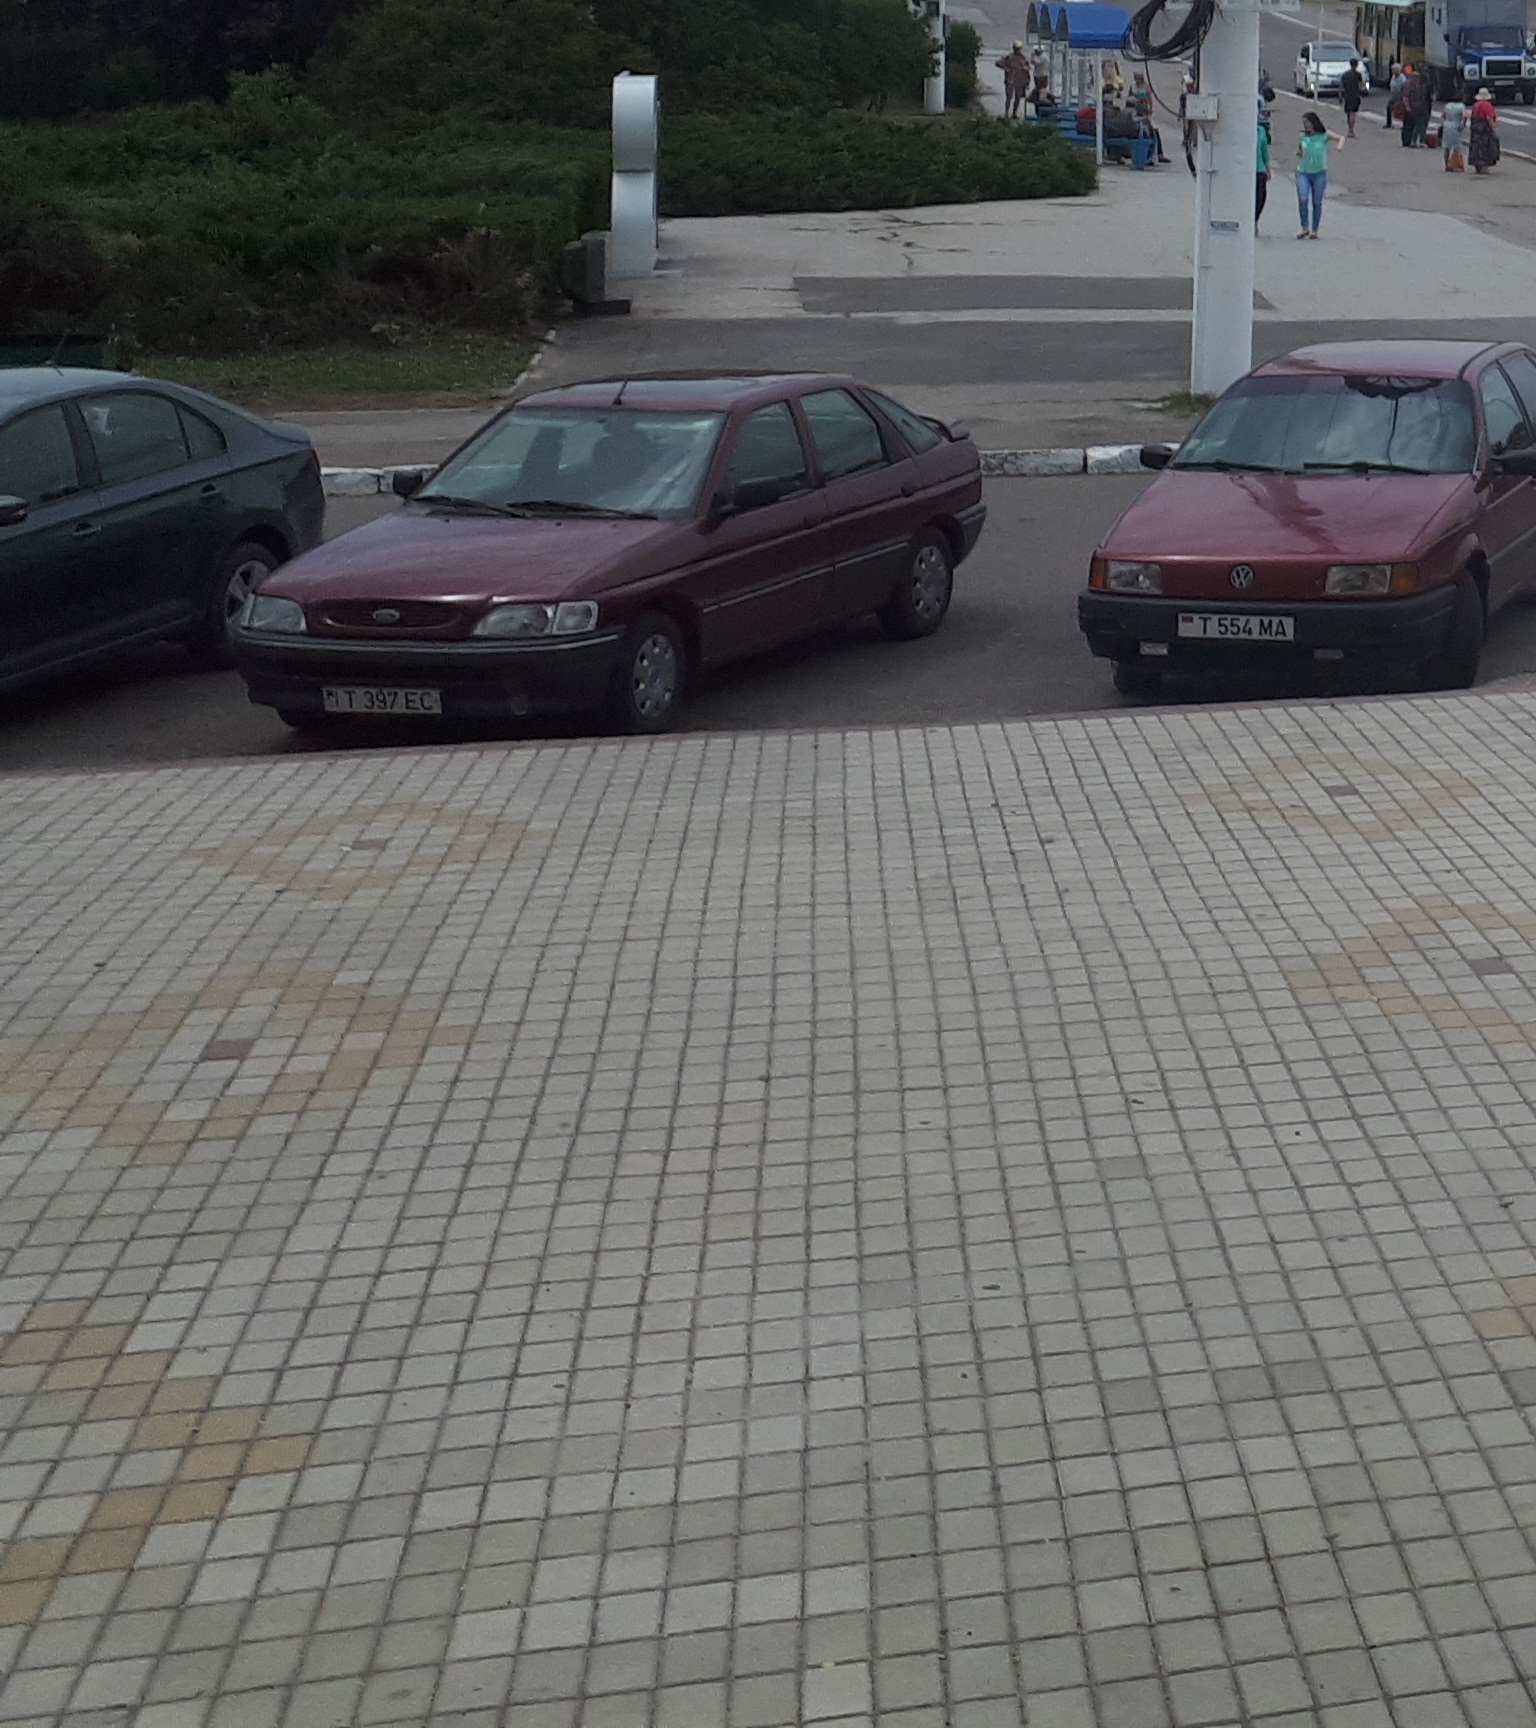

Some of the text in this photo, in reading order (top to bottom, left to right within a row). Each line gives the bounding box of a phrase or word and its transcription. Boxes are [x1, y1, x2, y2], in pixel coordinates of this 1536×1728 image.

[1198, 616, 1288, 638] T 554 MA
[342, 689, 435, 712] T 397 EC
